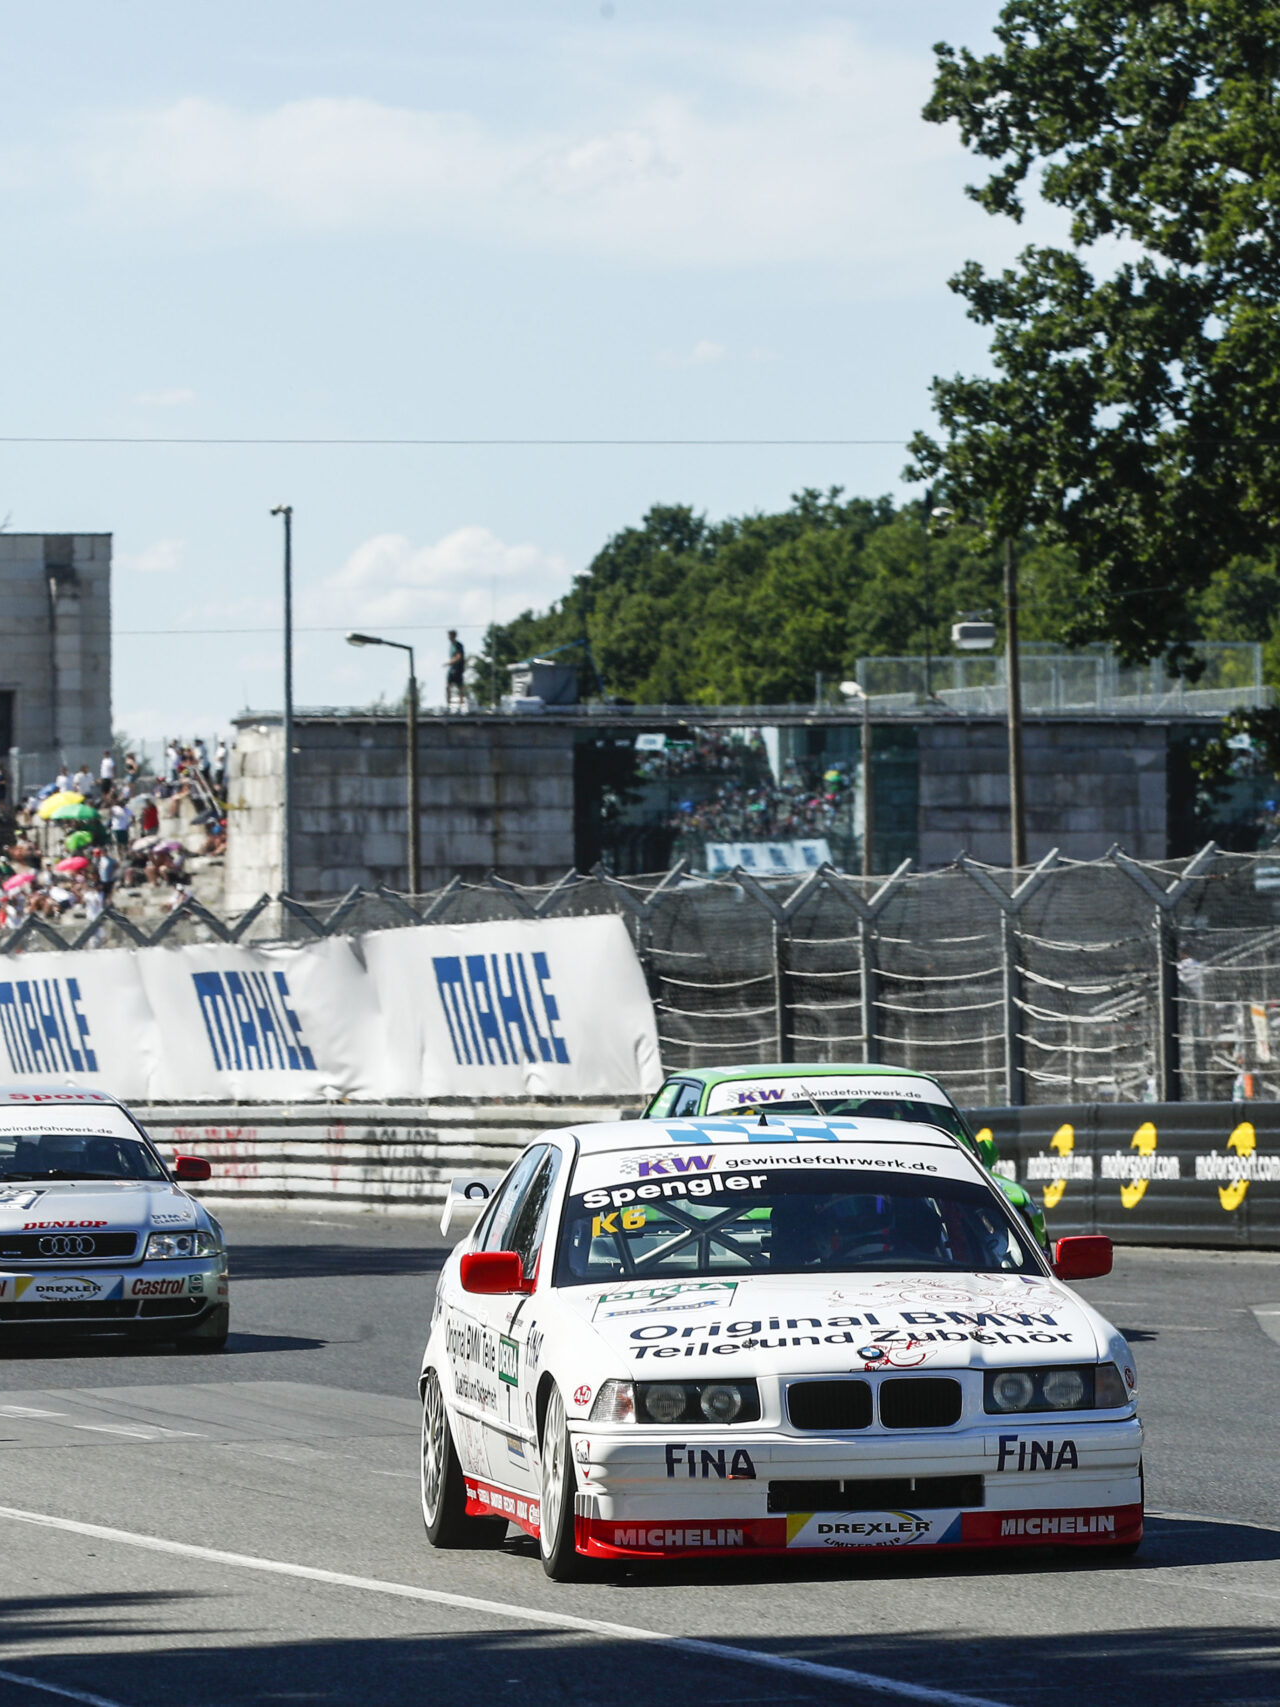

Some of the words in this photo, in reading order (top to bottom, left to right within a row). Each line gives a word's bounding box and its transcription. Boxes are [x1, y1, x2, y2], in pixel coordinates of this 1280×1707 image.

[431, 951, 571, 1066] MAHLE
[191, 971, 318, 1070] MAHLE
[8, 1093, 105, 1102] Sport
[738, 1088, 785, 1104] KW
[792, 1088, 922, 1099] gewindefahrwerk.de
[638, 1154, 716, 1177] KW
[725, 1155, 938, 1172] gewindefahrwerk.de
[582, 1173, 768, 1210] Spengler
[21, 1219, 109, 1231] DUNLOP
[592, 1208, 646, 1238] K6
[35, 1284, 102, 1294] DREXLER
[132, 1278, 186, 1296] Castrol
[605, 1283, 732, 1301] DEKRA
[629, 1313, 881, 1340] Original
[899, 1311, 1059, 1327] BMW
[629, 1343, 741, 1359] Teile
[756, 1332, 855, 1349] und
[870, 1329, 1074, 1345] Zubehör
[499, 1341, 519, 1380] DEKRA
[665, 1443, 757, 1479] FINA
[996, 1434, 1079, 1471] FINA
[614, 1528, 744, 1546] MICHELIN
[817, 1521, 931, 1537] DREXLER
[1000, 1515, 1116, 1537] MICHELIN
